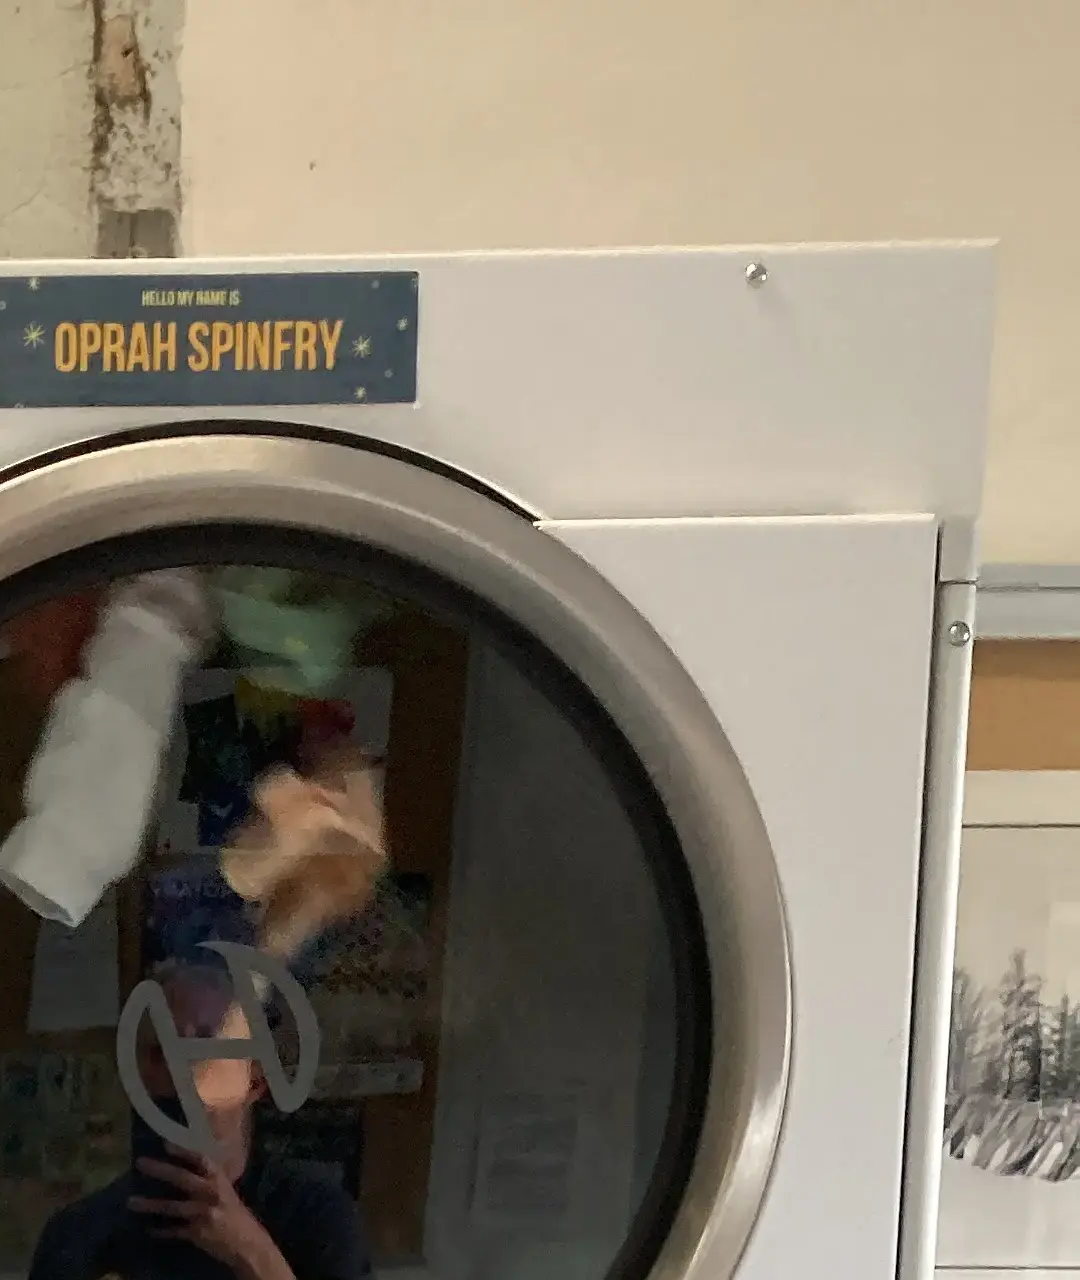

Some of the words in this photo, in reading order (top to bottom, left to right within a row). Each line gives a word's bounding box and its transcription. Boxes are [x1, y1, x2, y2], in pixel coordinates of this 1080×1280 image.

[142, 290, 175, 306] HELLO
[177, 290, 194, 306] MY
[196, 290, 227, 306] NAME
[229, 290, 240, 306] IS
[55, 321, 177, 373] OPRAH
[187, 319, 344, 372] SPINFRY
